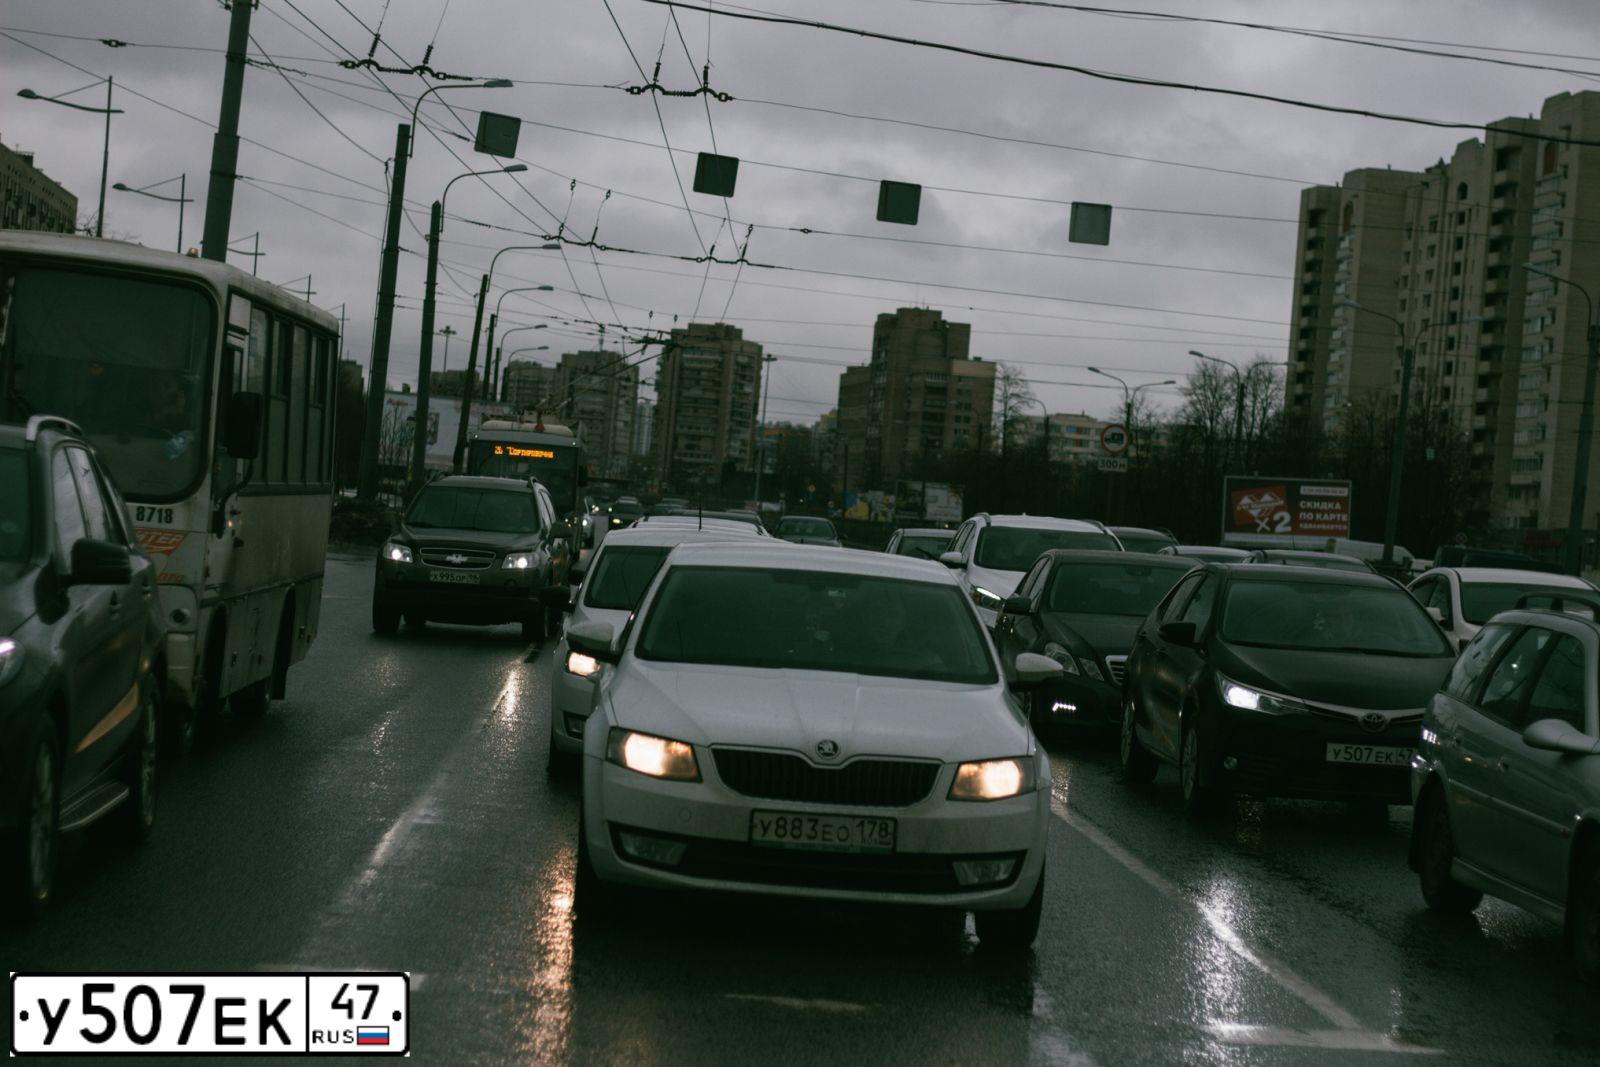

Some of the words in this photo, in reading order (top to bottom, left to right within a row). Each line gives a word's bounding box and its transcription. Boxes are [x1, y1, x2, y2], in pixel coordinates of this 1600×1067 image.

[1299, 499, 1342, 511] СКИДКА
[136, 506, 173, 524] 8718
[1299, 511, 1314, 521] ПО
[1316, 512, 1349, 523] КАРТЕ
